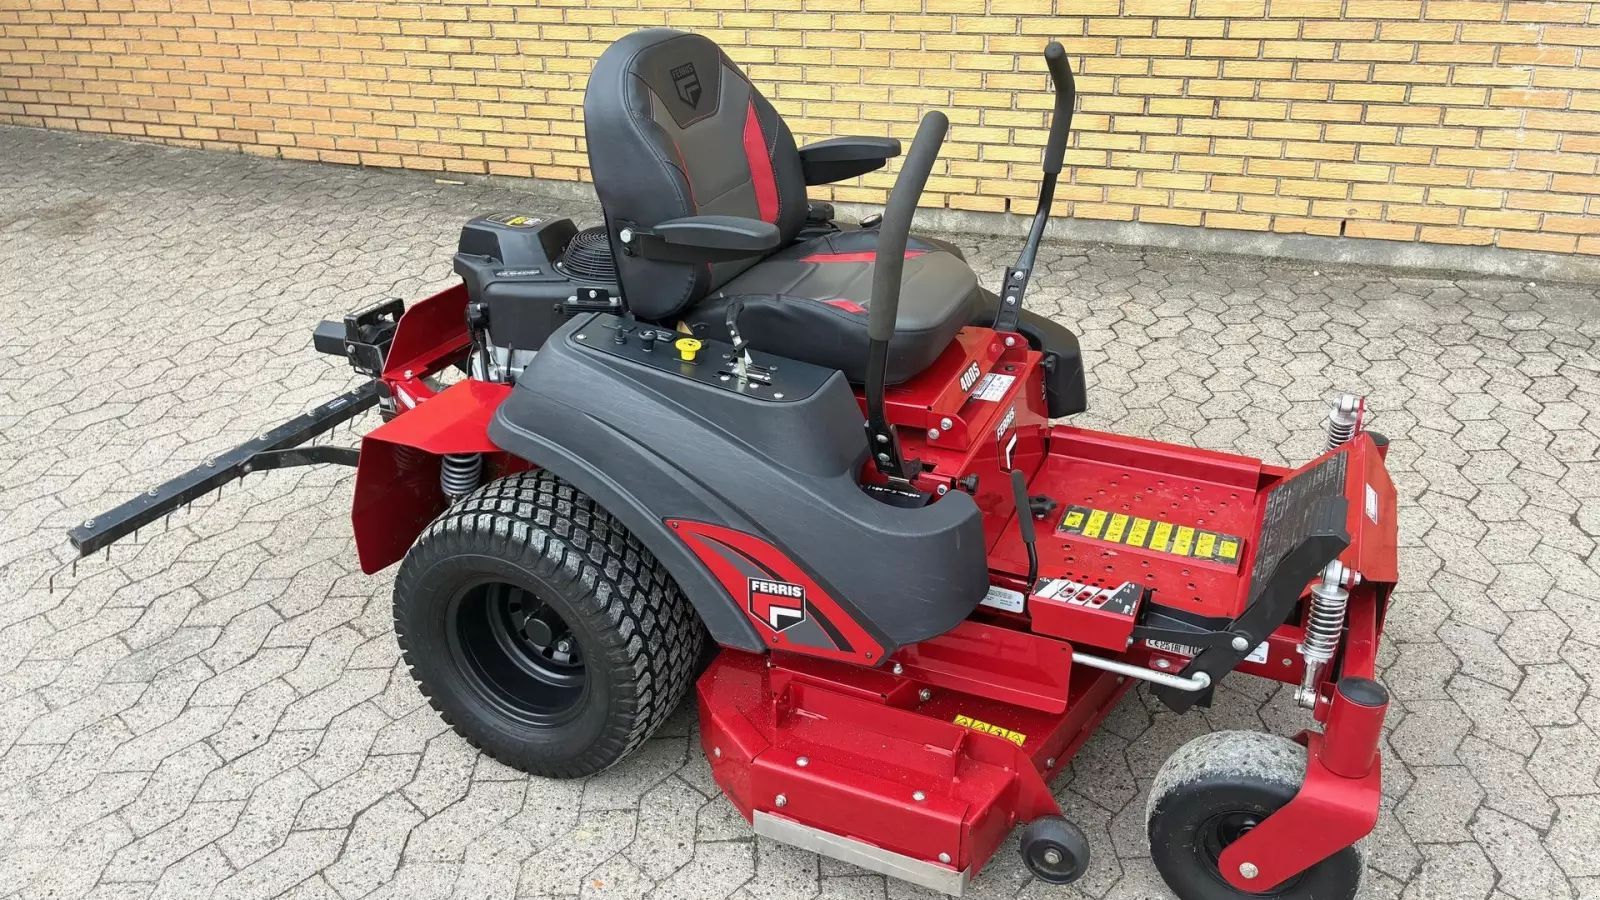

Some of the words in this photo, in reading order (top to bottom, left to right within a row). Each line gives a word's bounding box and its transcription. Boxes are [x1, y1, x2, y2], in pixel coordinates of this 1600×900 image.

[960, 361, 981, 392] 400S
[996, 406, 1015, 442] FERRIS
[751, 580, 802, 598] FERRIS
